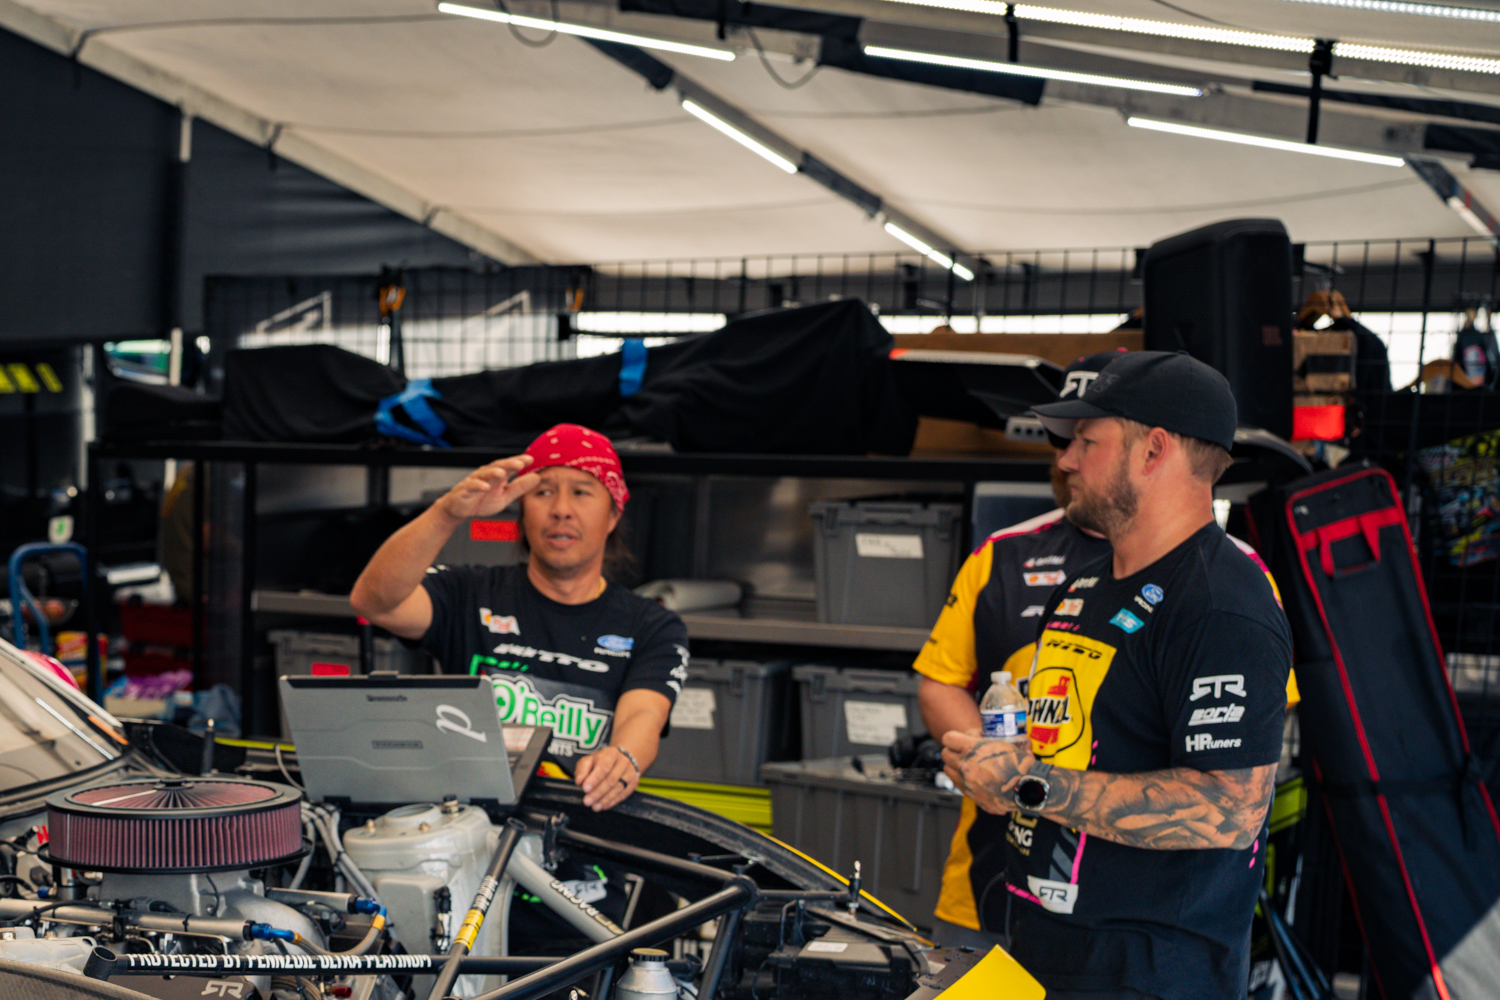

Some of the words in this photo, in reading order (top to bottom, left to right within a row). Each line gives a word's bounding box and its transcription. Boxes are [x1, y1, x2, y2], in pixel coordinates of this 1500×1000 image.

[1189, 674, 1247, 702] RTR
[492, 682, 604, 746] O'Reilly
[127, 953, 218, 969] PROTECTED
[223, 953, 242, 969] BY
[247, 953, 317, 969] PENNZOIL
[319, 953, 362, 969] ULTRA
[364, 953, 432, 969] PLATINUM
[200, 979, 243, 1000] RTR
